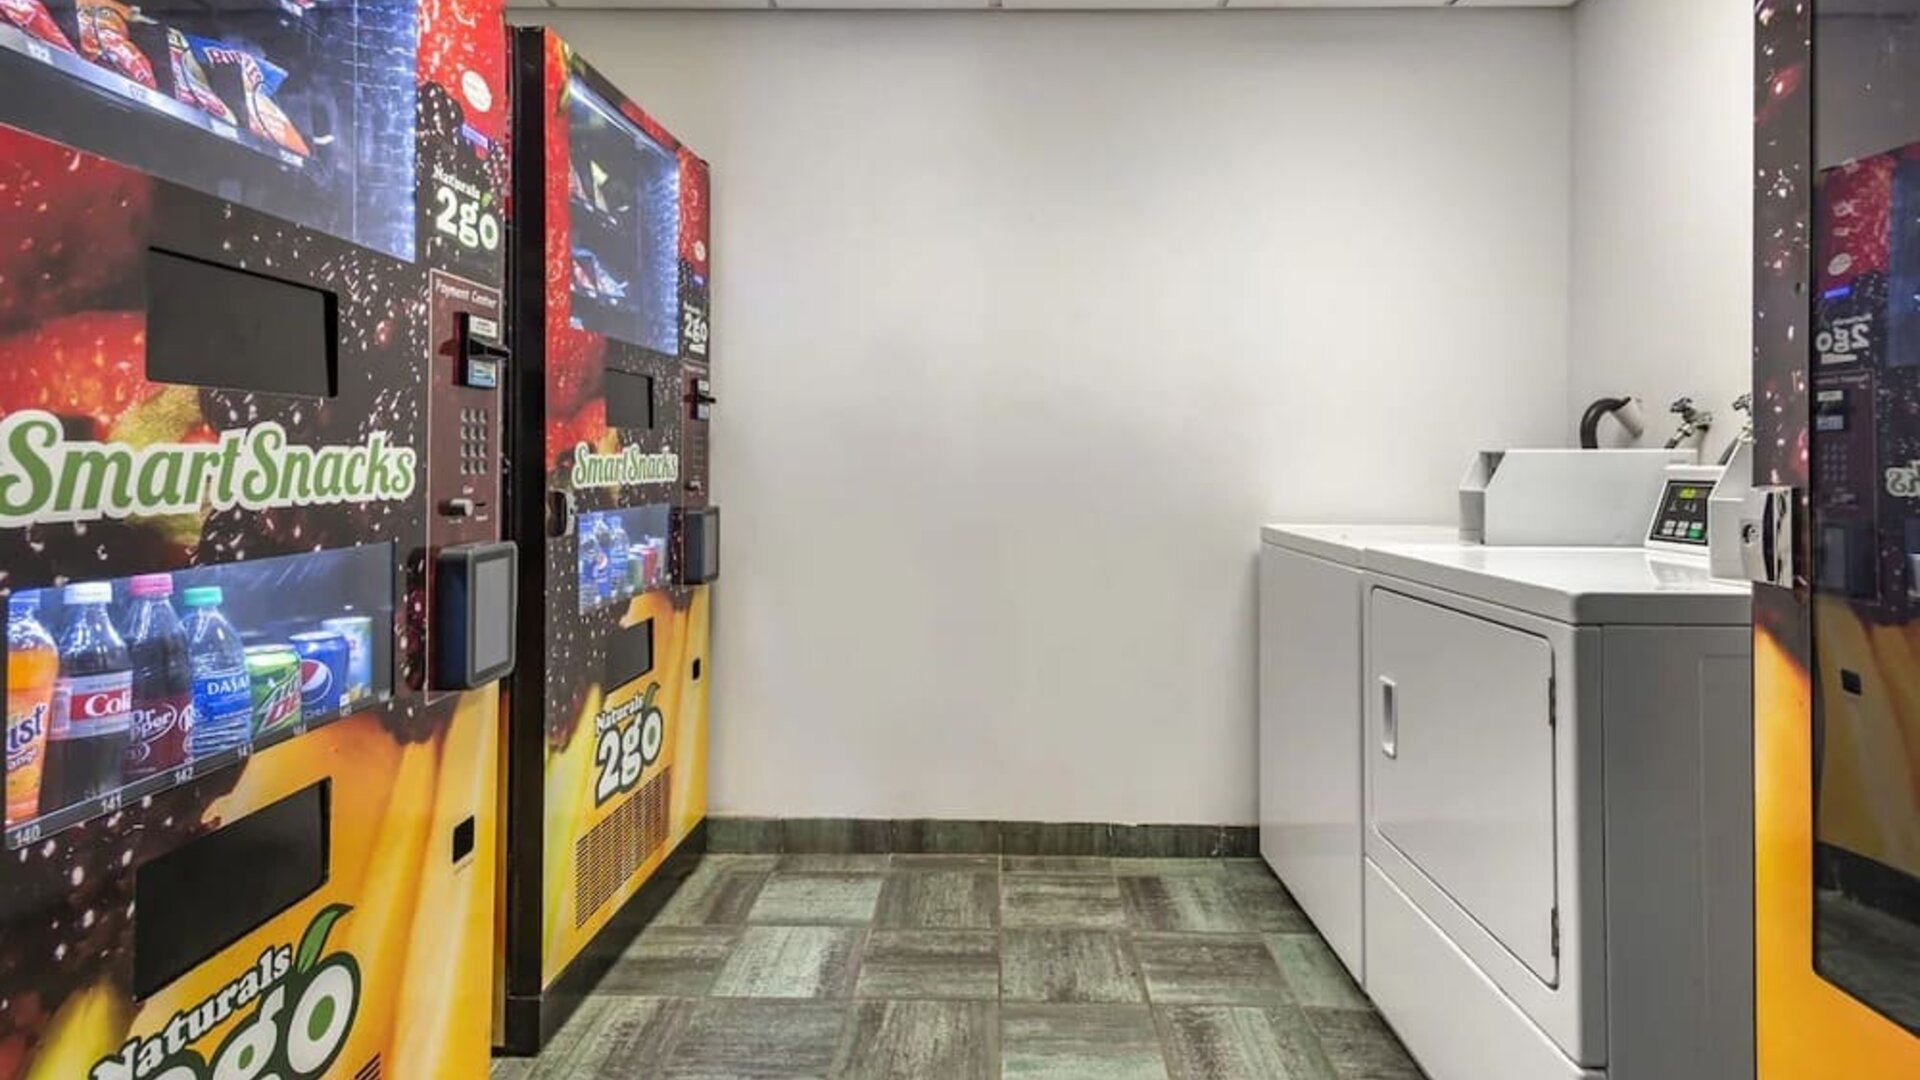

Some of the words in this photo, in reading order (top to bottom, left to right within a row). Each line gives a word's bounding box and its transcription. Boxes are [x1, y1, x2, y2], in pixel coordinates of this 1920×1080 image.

[436, 186, 500, 251] 2go
[0, 411, 416, 526] SmartSnacks
[573, 443, 678, 488] SmartSnacks
[597, 690, 645, 734] Naturals
[597, 712, 662, 803] 2go
[90, 945, 293, 1080] Naturals
